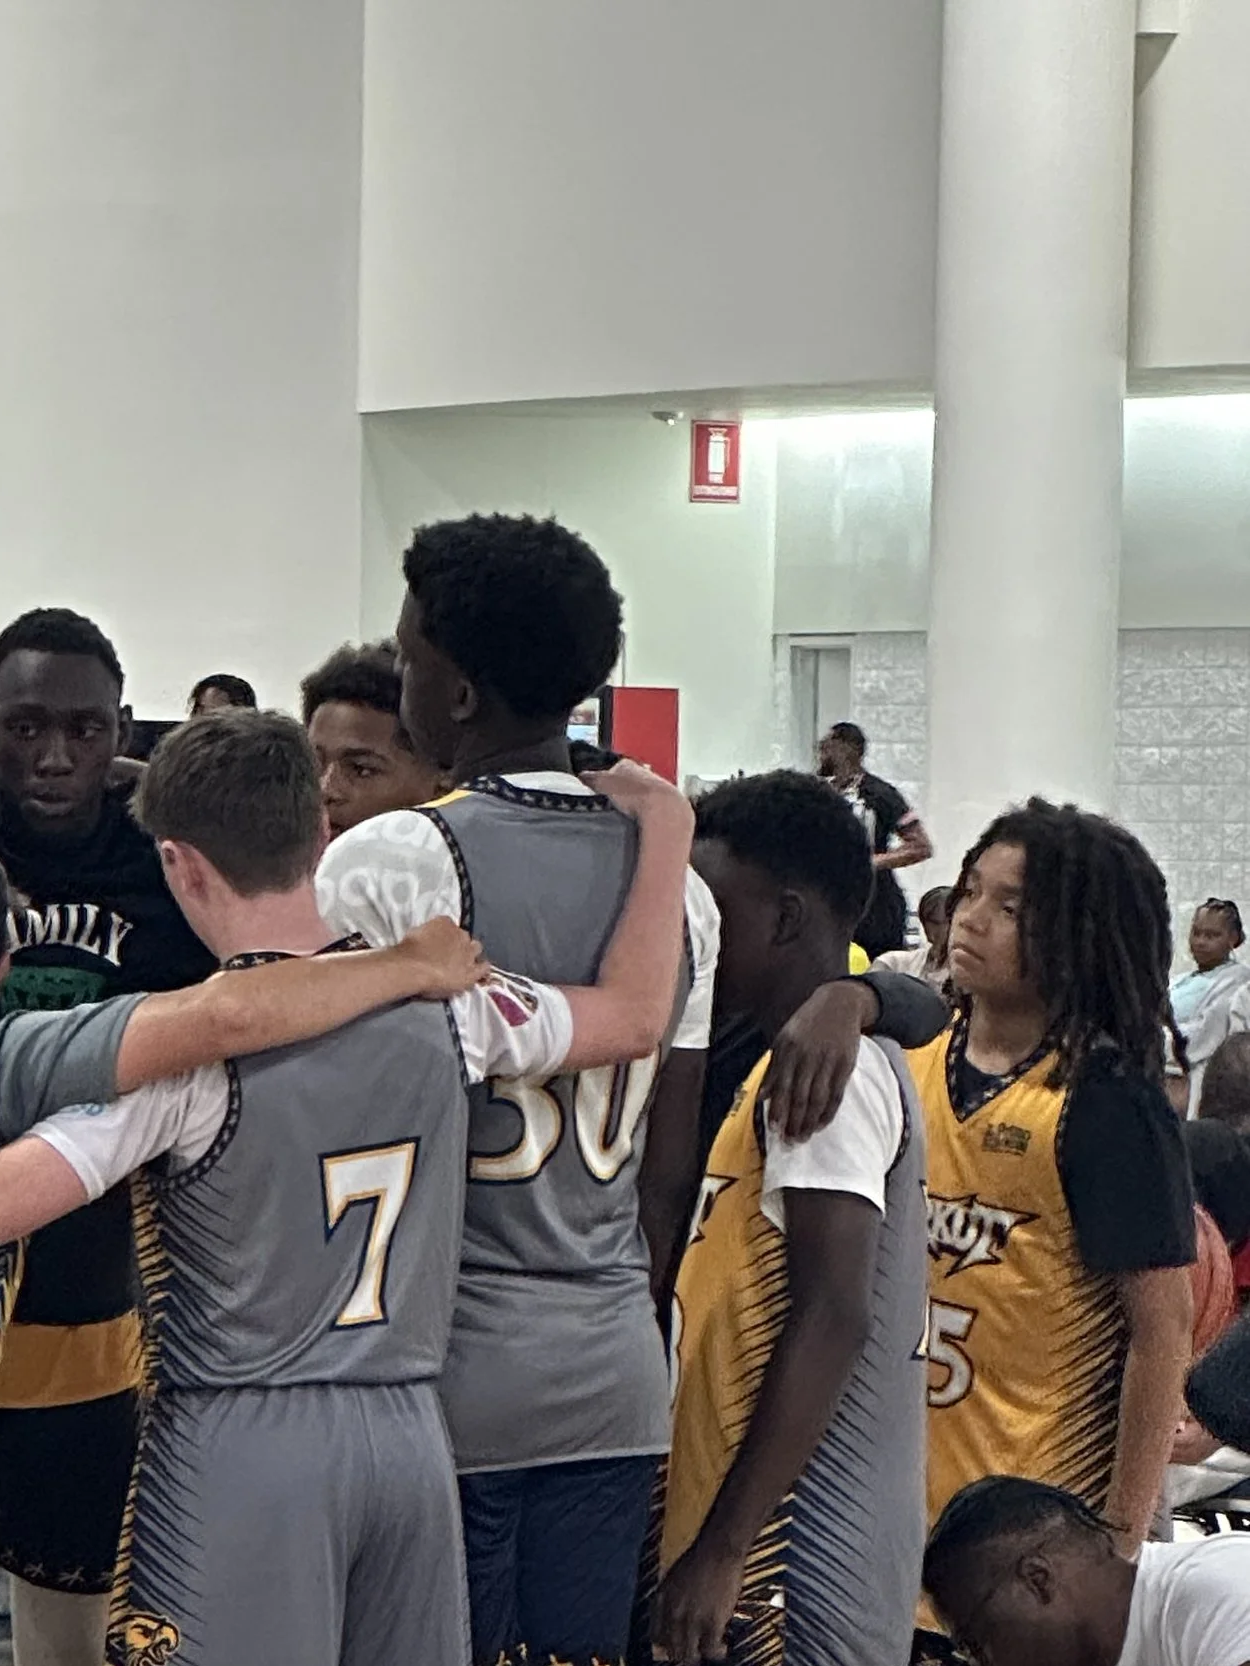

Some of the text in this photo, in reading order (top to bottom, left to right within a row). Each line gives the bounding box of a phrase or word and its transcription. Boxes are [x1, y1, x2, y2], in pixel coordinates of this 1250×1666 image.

[6, 904, 134, 967] AMILY
[318, 1136, 422, 1331] 7
[927, 1296, 979, 1409] 5
